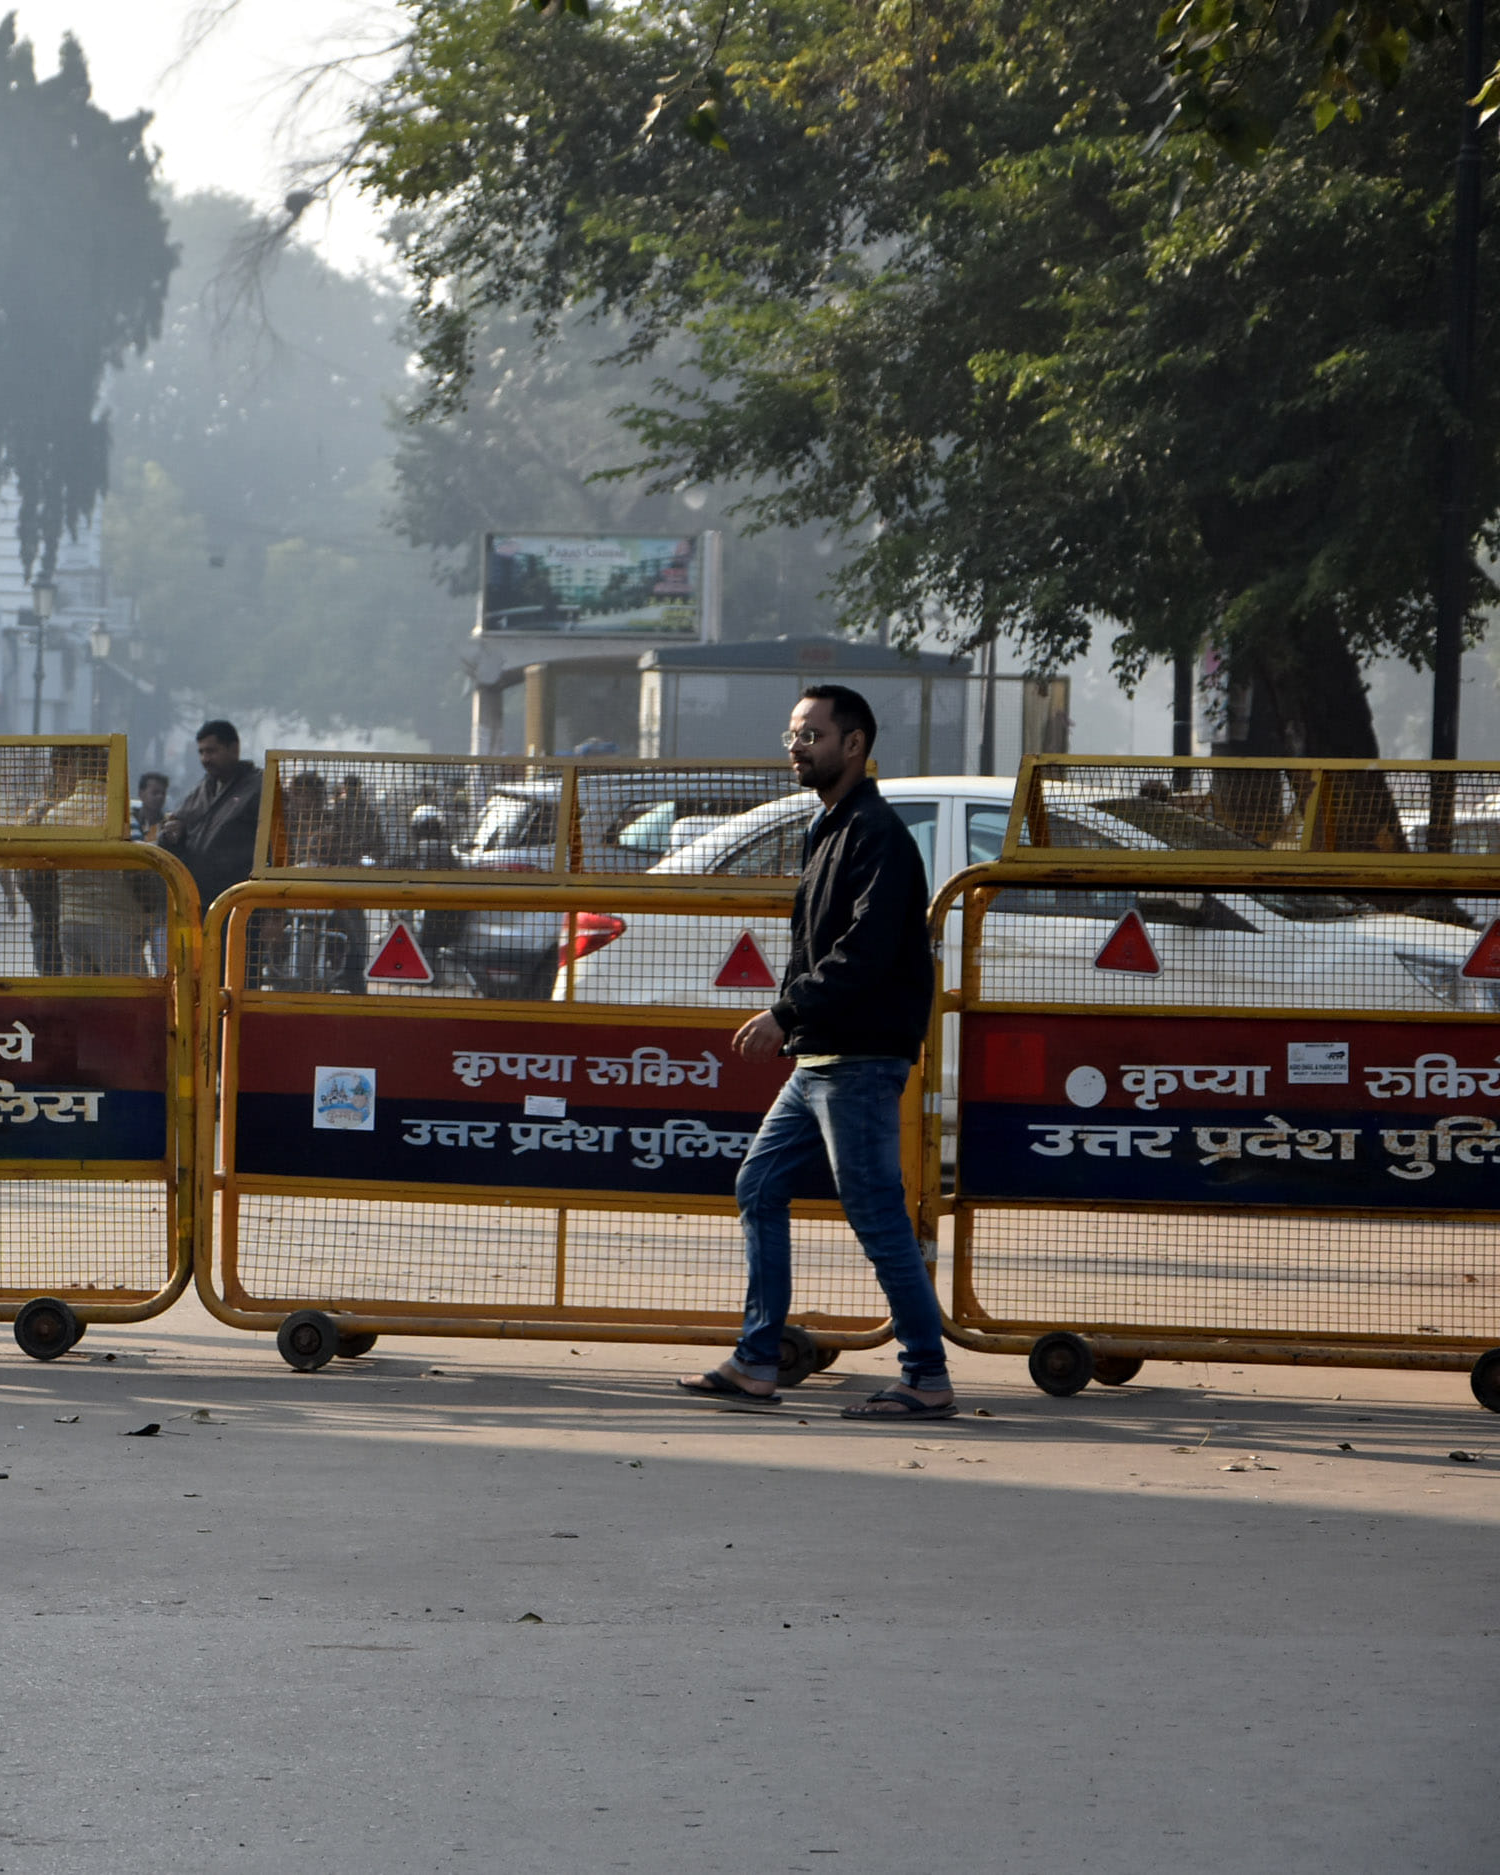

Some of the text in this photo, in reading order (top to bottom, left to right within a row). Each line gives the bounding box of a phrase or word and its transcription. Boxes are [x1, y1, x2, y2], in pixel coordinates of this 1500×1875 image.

[452, 1051, 578, 1088] कृपया
[401, 1119, 501, 1149] उत्तर
[508, 1119, 623, 1156] प्रदेश
[1027, 1124, 1180, 1159] उत्तर
[1192, 1114, 1363, 1167] प्रदेश
